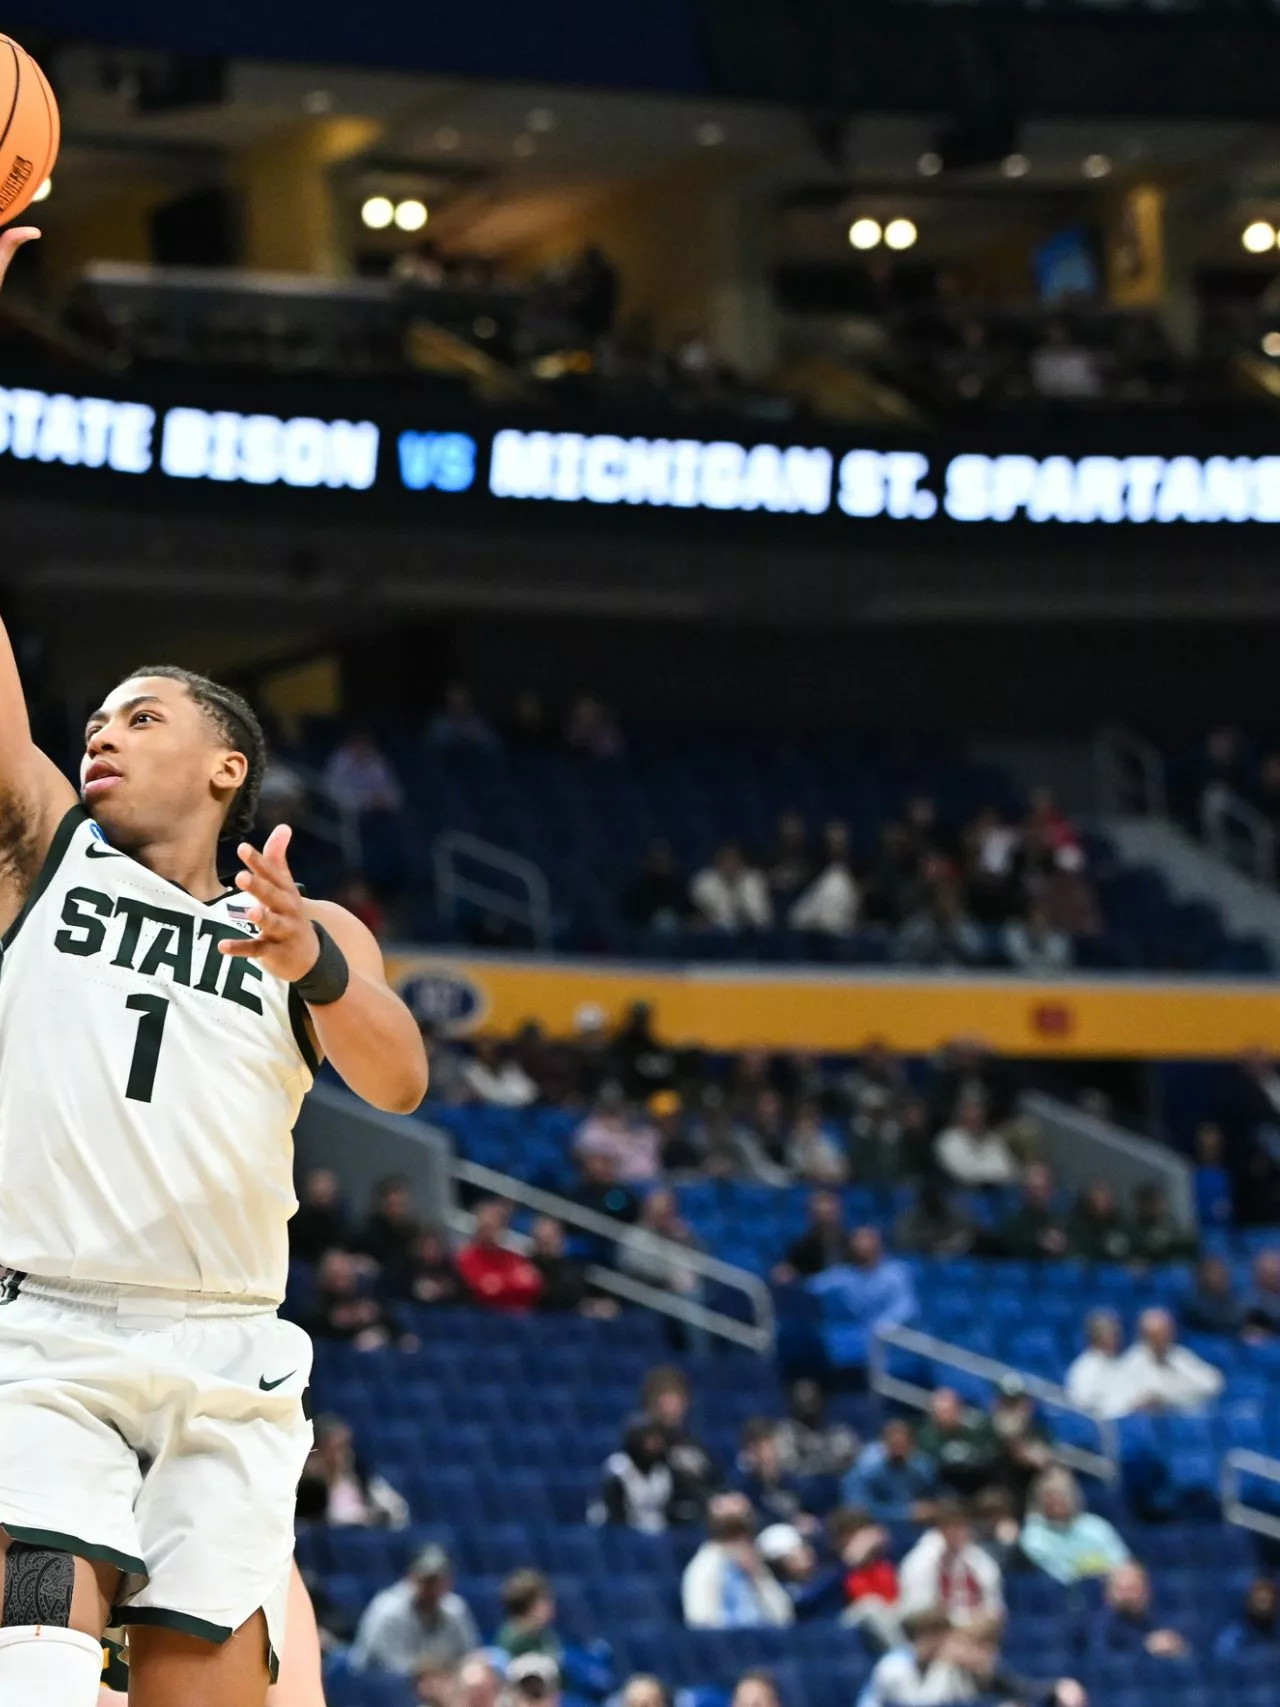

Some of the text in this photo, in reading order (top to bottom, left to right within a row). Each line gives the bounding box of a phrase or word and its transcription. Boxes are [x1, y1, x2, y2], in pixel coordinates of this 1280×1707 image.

[160, 406, 379, 490] BISON
[397, 429, 477, 492] VS
[489, 428, 833, 514] MICHIGAN
[837, 448, 938, 521] ST.
[54, 886, 264, 1017] STATE
[125, 993, 170, 1104] 1
